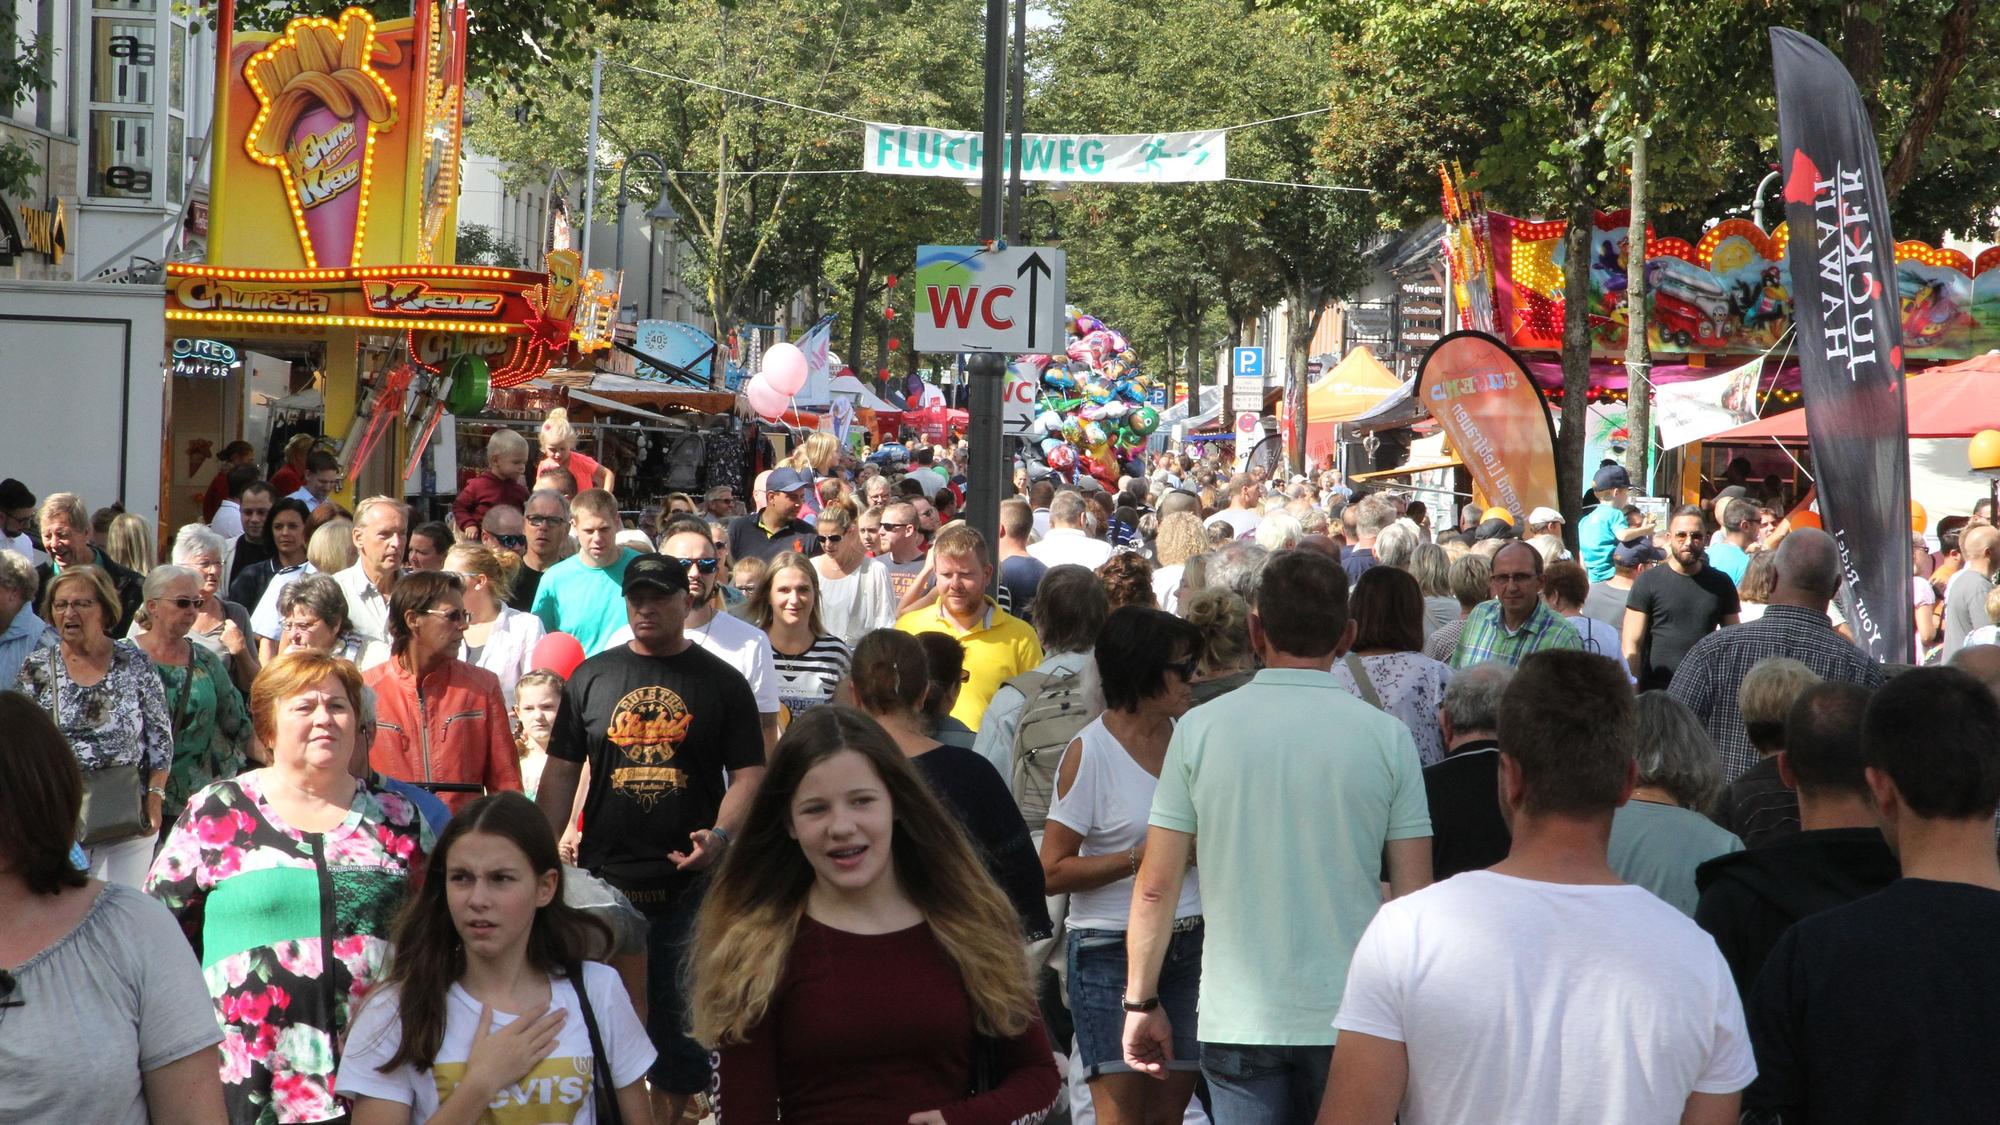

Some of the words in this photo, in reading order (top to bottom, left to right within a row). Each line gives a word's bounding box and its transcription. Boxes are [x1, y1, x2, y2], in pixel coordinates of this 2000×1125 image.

[299, 163, 359, 206] Kreuz
[364, 281, 502, 313] Kreuz
[926, 285, 1016, 330] WC
[173, 338, 235, 361] OREO
[164, 361, 230, 382] hurros
[1240, 350, 1257, 374] P
[1154, 390, 1165, 404] P
